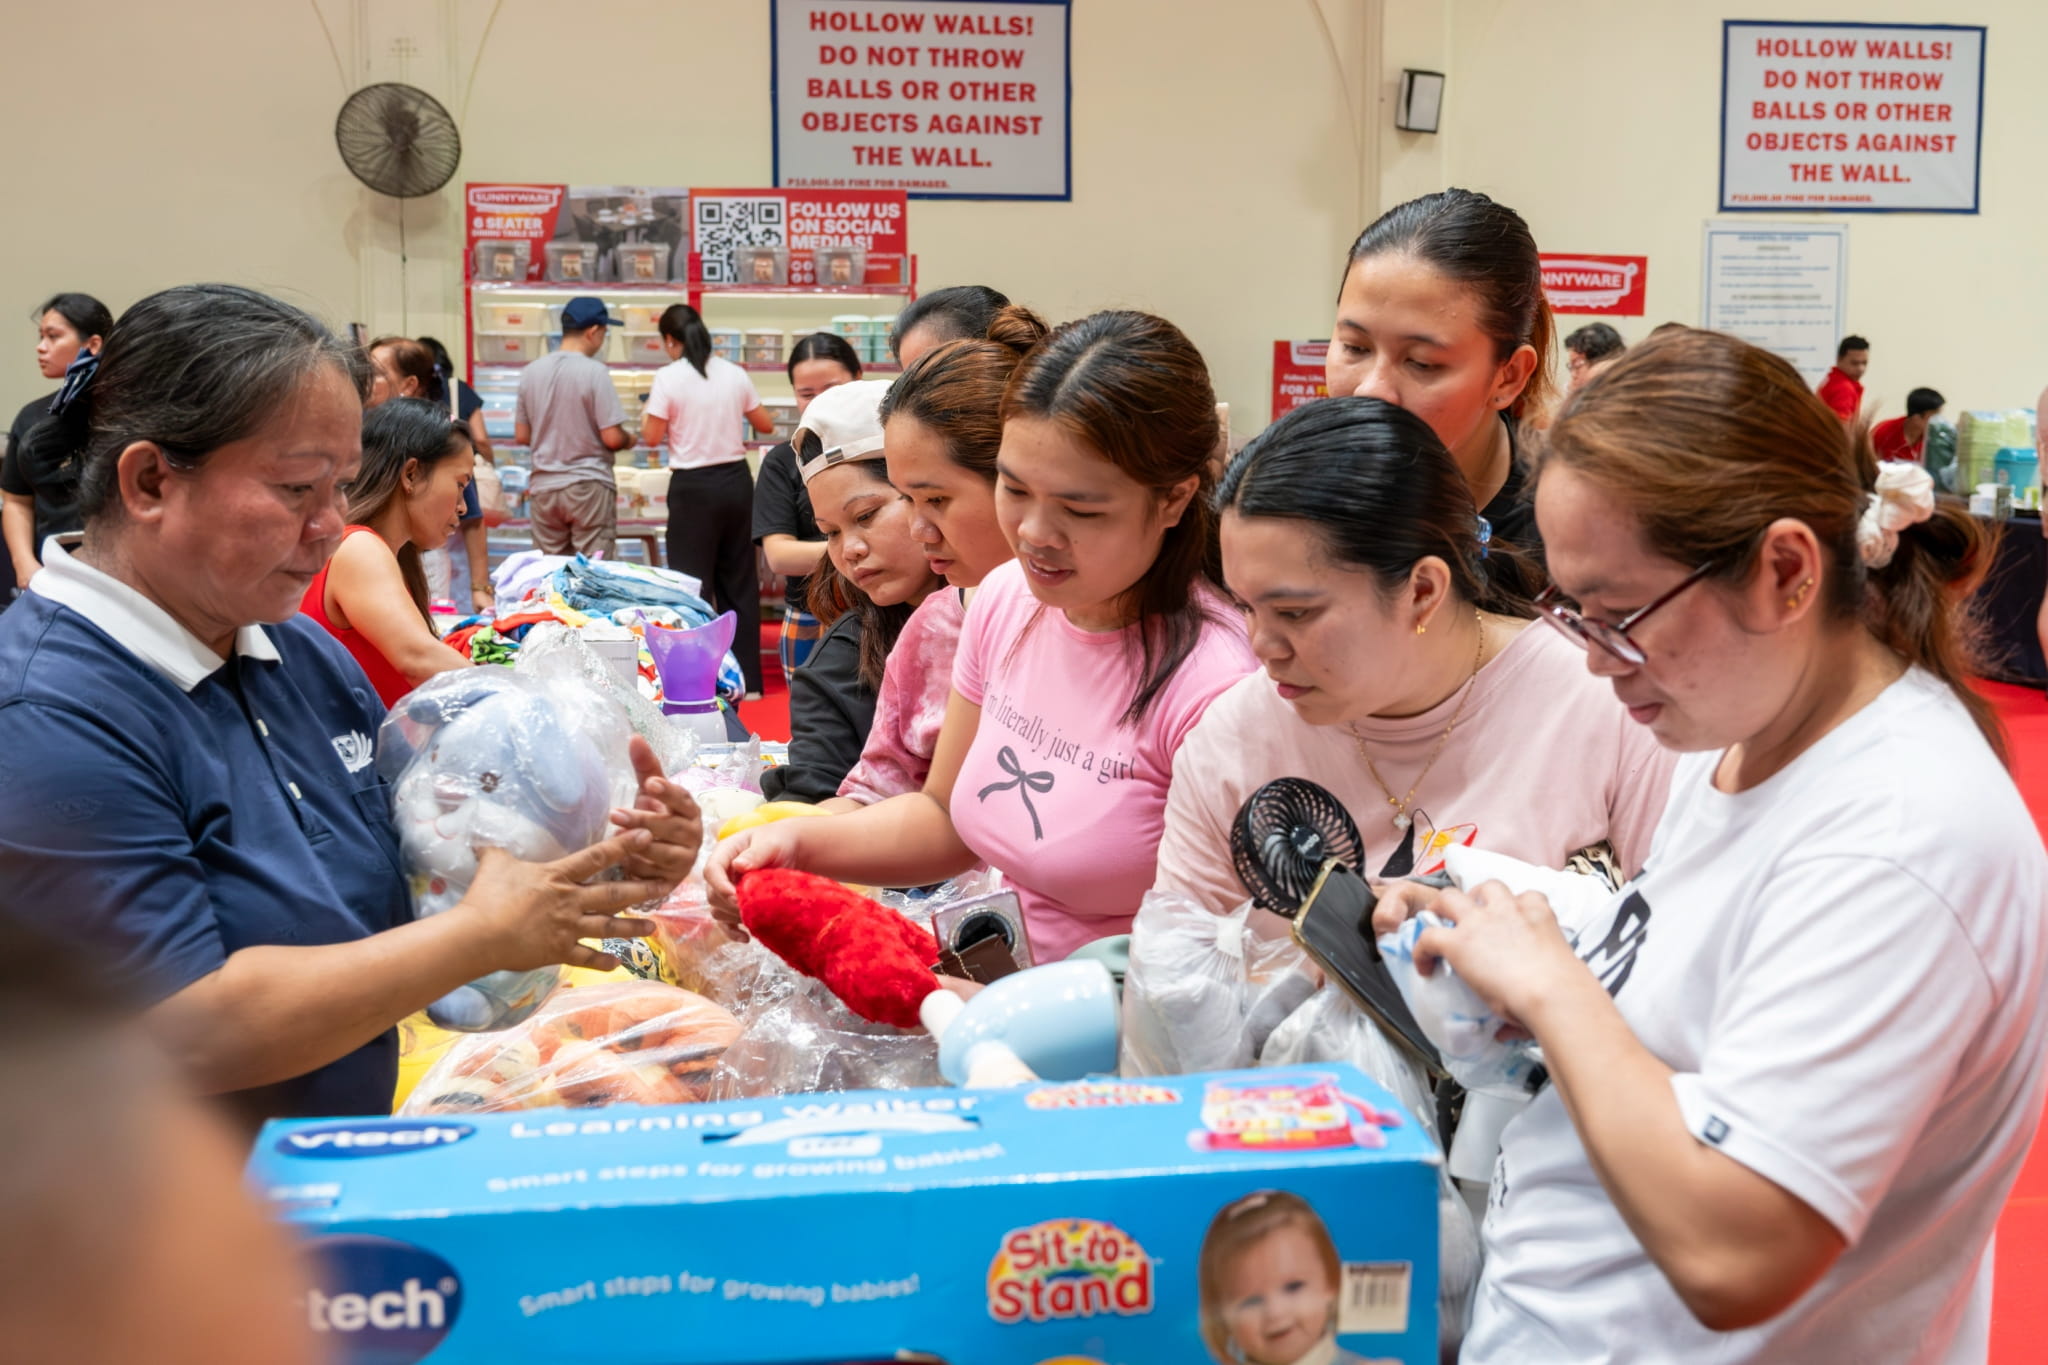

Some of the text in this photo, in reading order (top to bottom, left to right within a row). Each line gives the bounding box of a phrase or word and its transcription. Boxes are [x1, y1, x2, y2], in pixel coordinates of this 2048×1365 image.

[809, 11, 1033, 36] HOLLOW WALLS!
[819, 45, 1024, 69] DO NOT THROW
[1756, 38, 1953, 60] HOLLOW WALLS!
[807, 78, 1037, 102] BALLS OR OTHER
[1763, 70, 1943, 91] DO NOT THROW
[1752, 101, 1952, 122] BALLS OR OTHER
[802, 112, 1043, 135] OBJECTS AGAINST
[1746, 132, 1957, 153] OBJECTS AGAINST
[853, 146, 992, 168] THE WALL.
[849, 178, 871, 187] FINE
[874, 179, 895, 188] FOR
[1790, 163, 1911, 183] THE WALL.
[475, 192, 551, 203] SUNNYWARE
[790, 202, 901, 219] FOLLOW US
[473, 217, 543, 230] 6 SEATER
[790, 218, 896, 235] ON SOCIAL
[791, 234, 874, 250] MEDIAS!
[1541, 271, 1622, 288] NNYWARE
[1280, 384, 1304, 395] FOR
[1306, 384, 1316, 395] A
[996, 695, 1049, 752] literally
[1043, 728, 1081, 765] just
[1082, 750, 1095, 771] a
[1097, 752, 1136, 784] girl
[511, 1097, 978, 1138] Learning Walker
[289, 1126, 460, 1148] vtech
[487, 1142, 1006, 1192] Smart steps for growing babies!
[519, 1270, 920, 1317] Smart steps for growing babies!
[993, 1262, 1149, 1318] Stand
[307, 1278, 447, 1332] tech
